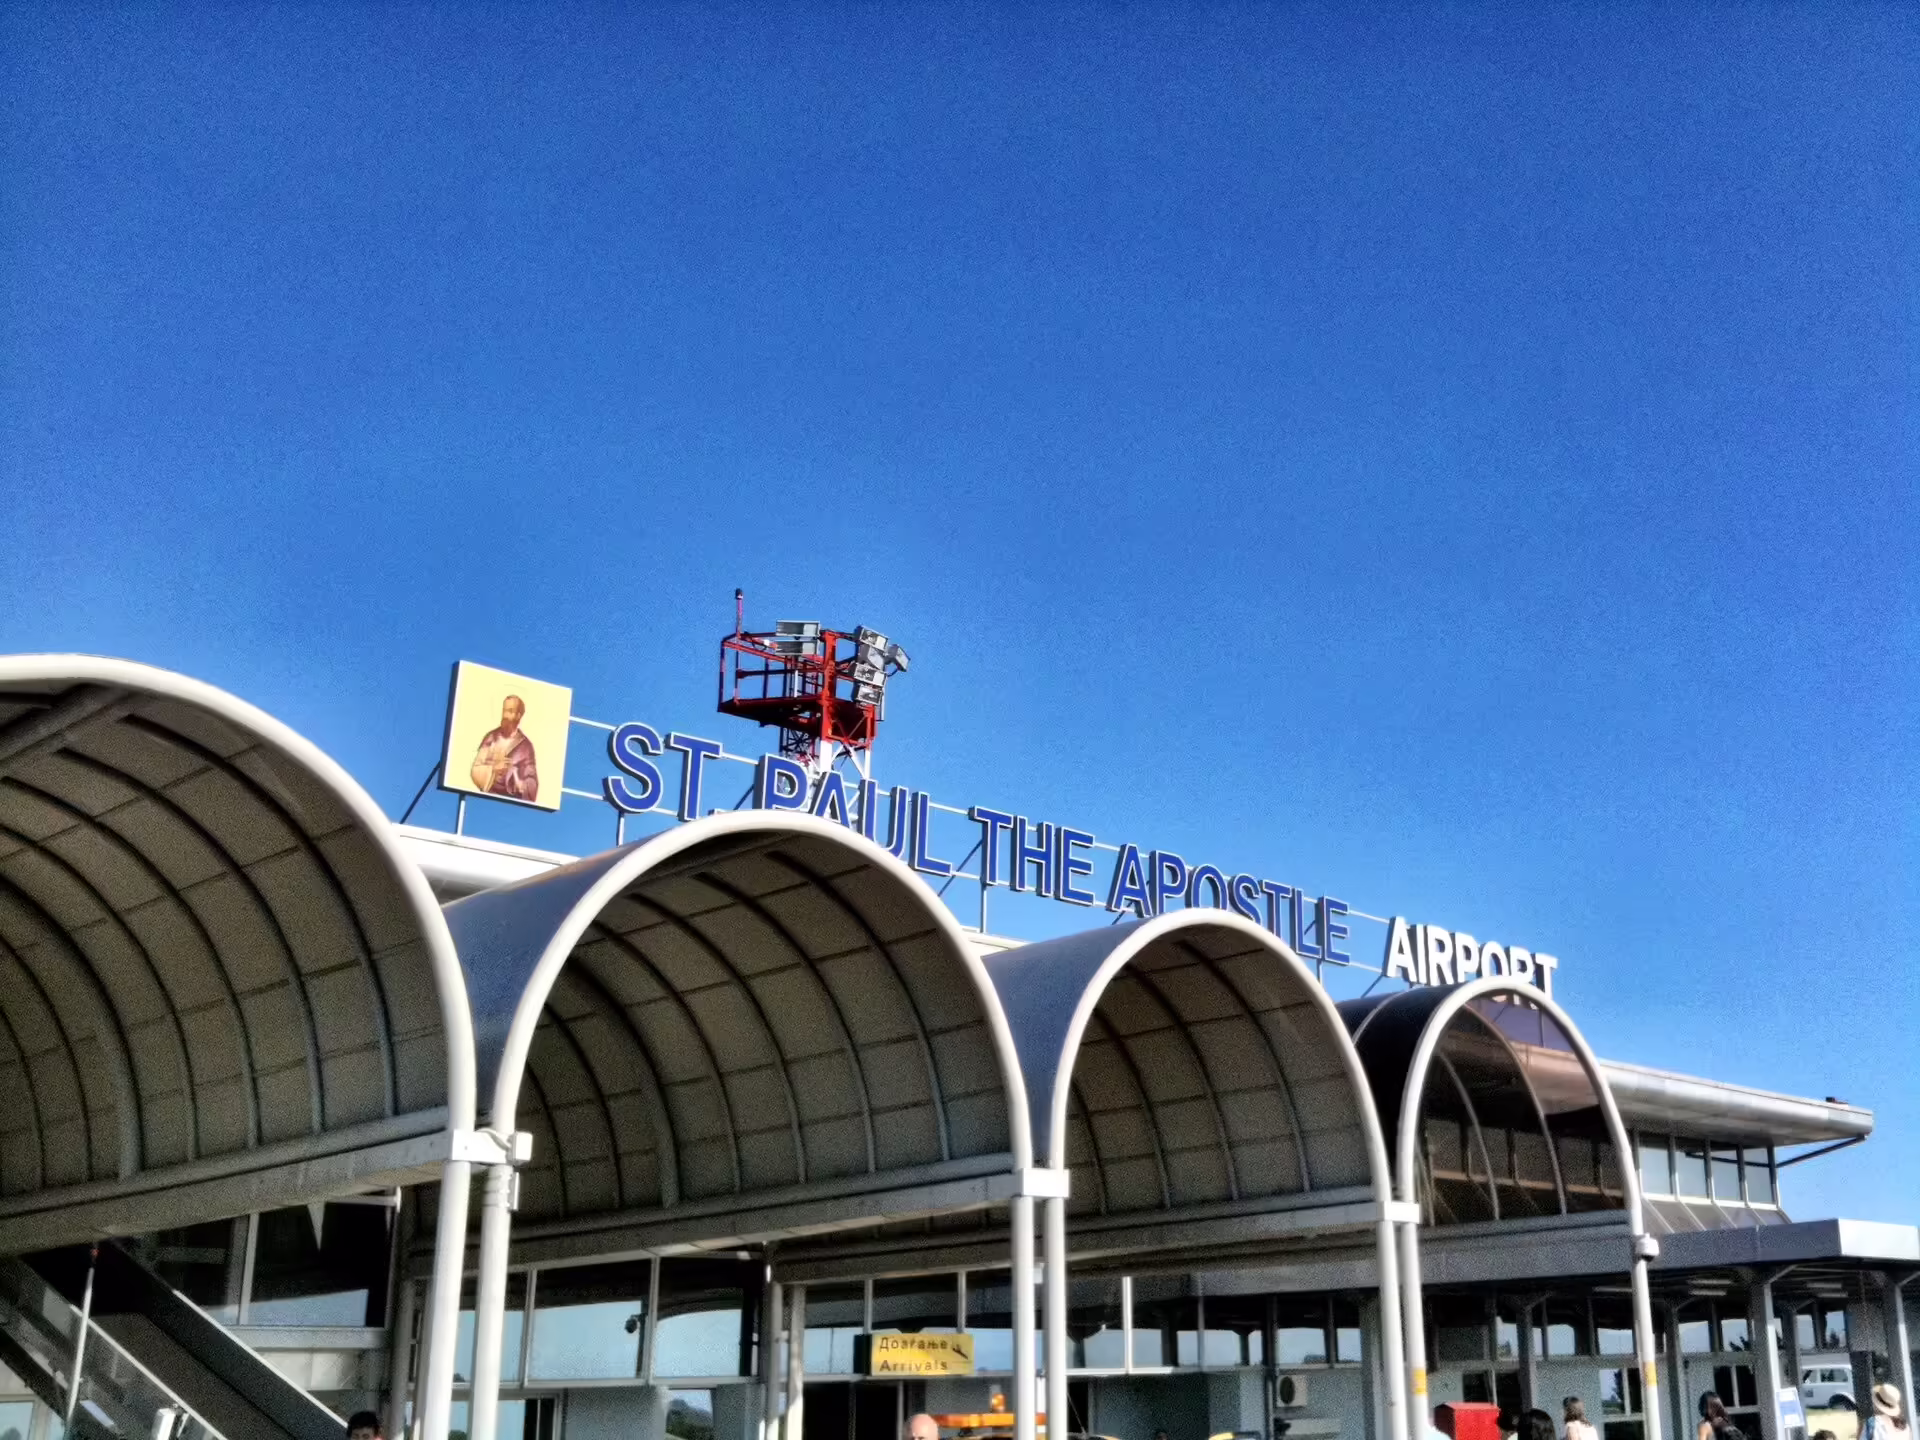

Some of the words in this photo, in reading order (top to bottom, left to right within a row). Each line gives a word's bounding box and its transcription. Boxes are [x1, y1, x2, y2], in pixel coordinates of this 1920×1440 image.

[752, 753, 953, 877] PAUL
[968, 806, 1096, 906] THE
[1105, 843, 1350, 965] APOSTLE
[1383, 916, 1559, 1002] AIRPORT
[879, 1359, 949, 1372] Arrivals
